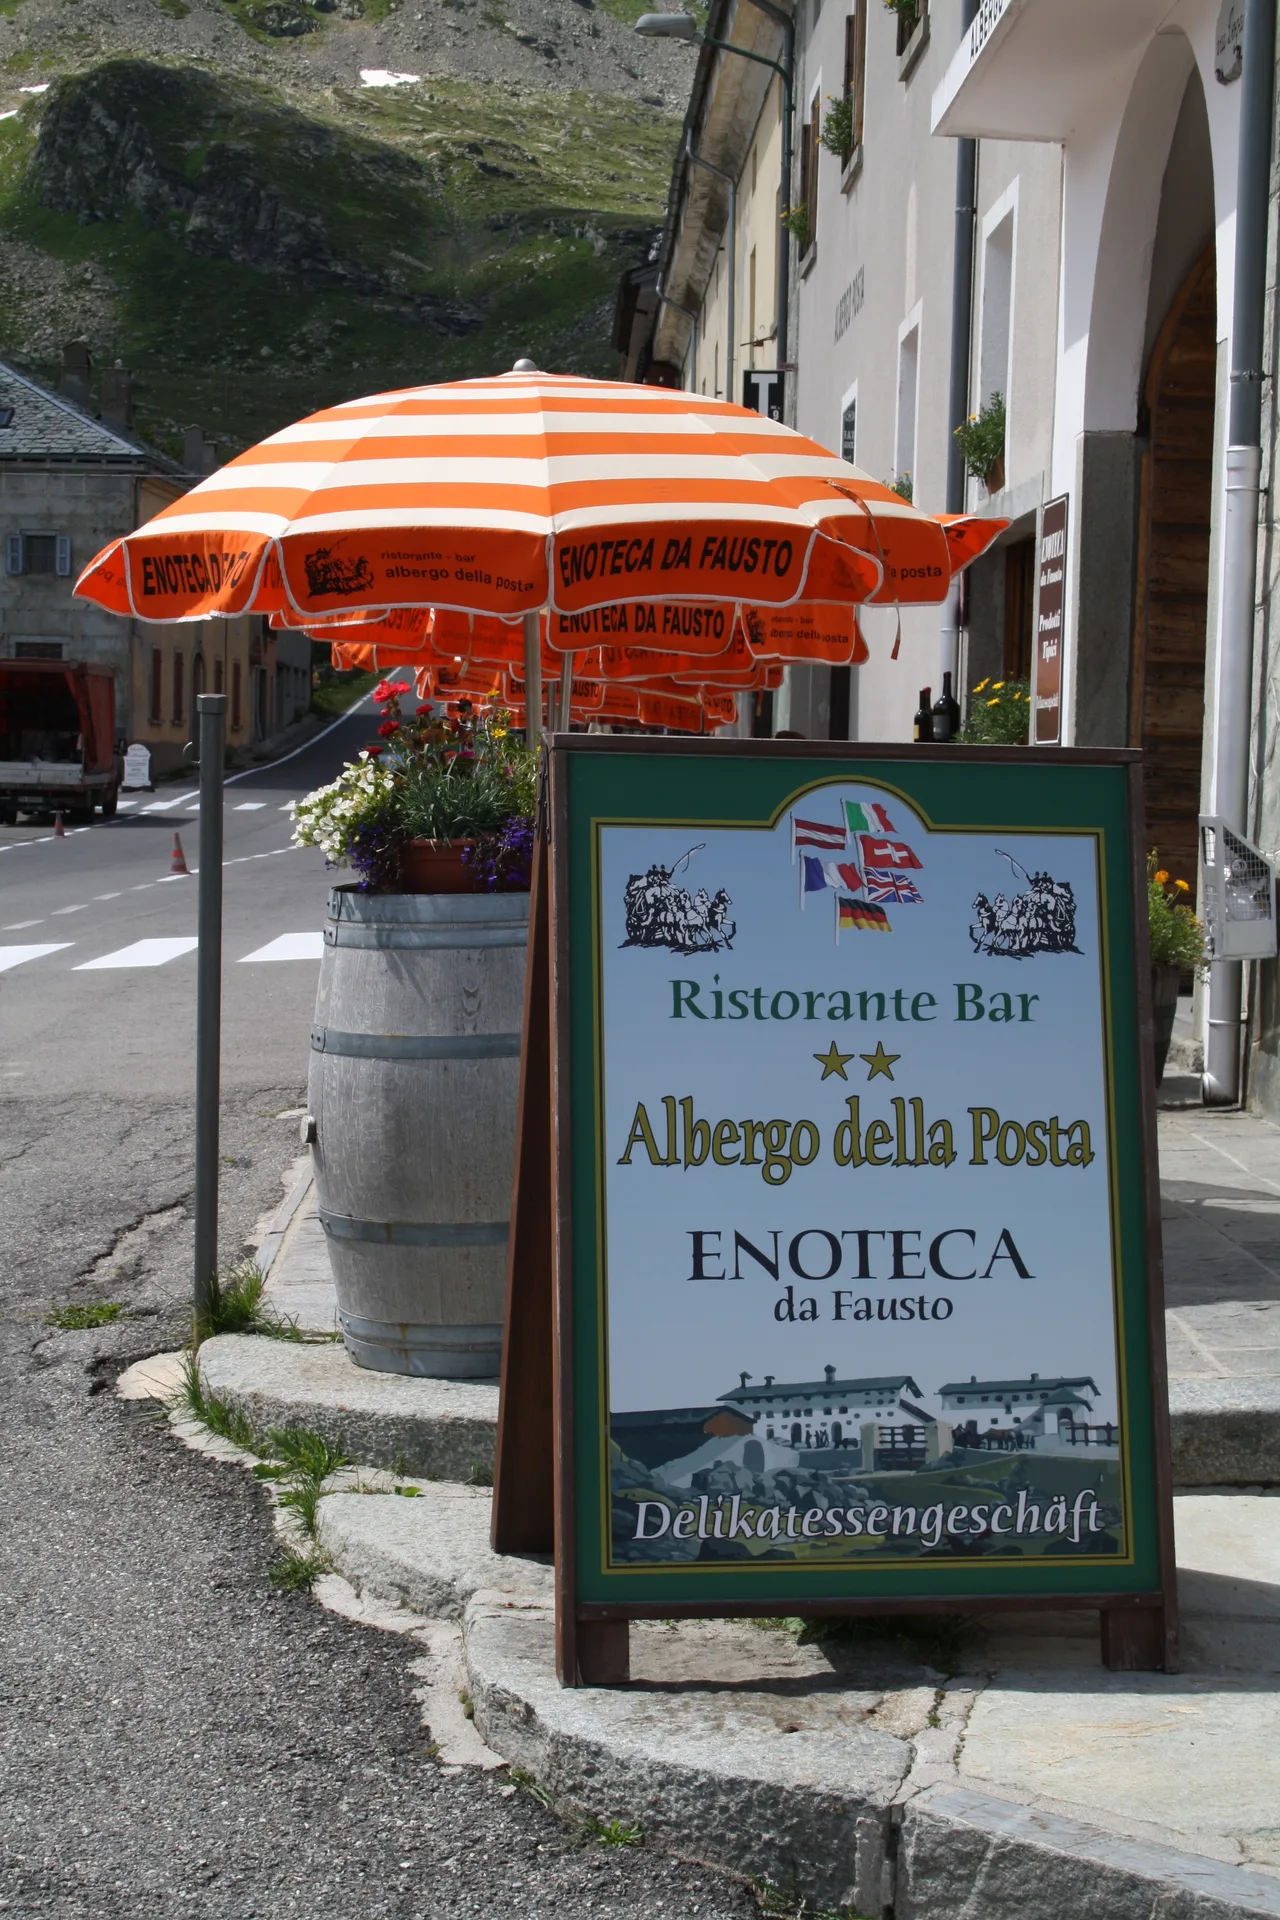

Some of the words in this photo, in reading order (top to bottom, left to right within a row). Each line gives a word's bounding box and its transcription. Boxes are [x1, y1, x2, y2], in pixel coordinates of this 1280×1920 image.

[750, 373, 778, 417] T
[772, 409, 780, 421] 9
[381, 551, 442, 561] ristorante
[455, 553, 476, 563] bar
[559, 538, 655, 588] ENOTECA
[660, 536, 693, 570] DA
[699, 536, 793, 578] FAUSTO
[901, 565, 942, 580] posta
[386, 566, 449, 581] albergo
[455, 568, 491, 585] della
[496, 576, 534, 593] posta
[559, 604, 629, 633] ENOTECA
[635, 604, 656, 633] DA
[662, 606, 725, 639] FAUSTO
[1039, 609, 1060, 632] Prodotti
[821, 634, 849, 643] osta
[571, 682, 600, 698] AUSTO
[668, 973, 939, 1022] Ristorante
[953, 982, 1040, 1023] Bar
[617, 1095, 821, 1186] Albergo
[833, 1094, 957, 1169] della
[967, 1106, 1096, 1170] Posta
[686, 1228, 1037, 1282] ENOTECA
[773, 1285, 820, 1323] da
[830, 1289, 954, 1322] Fausto
[632, 1486, 1103, 1548] Delikatessengeschäft
